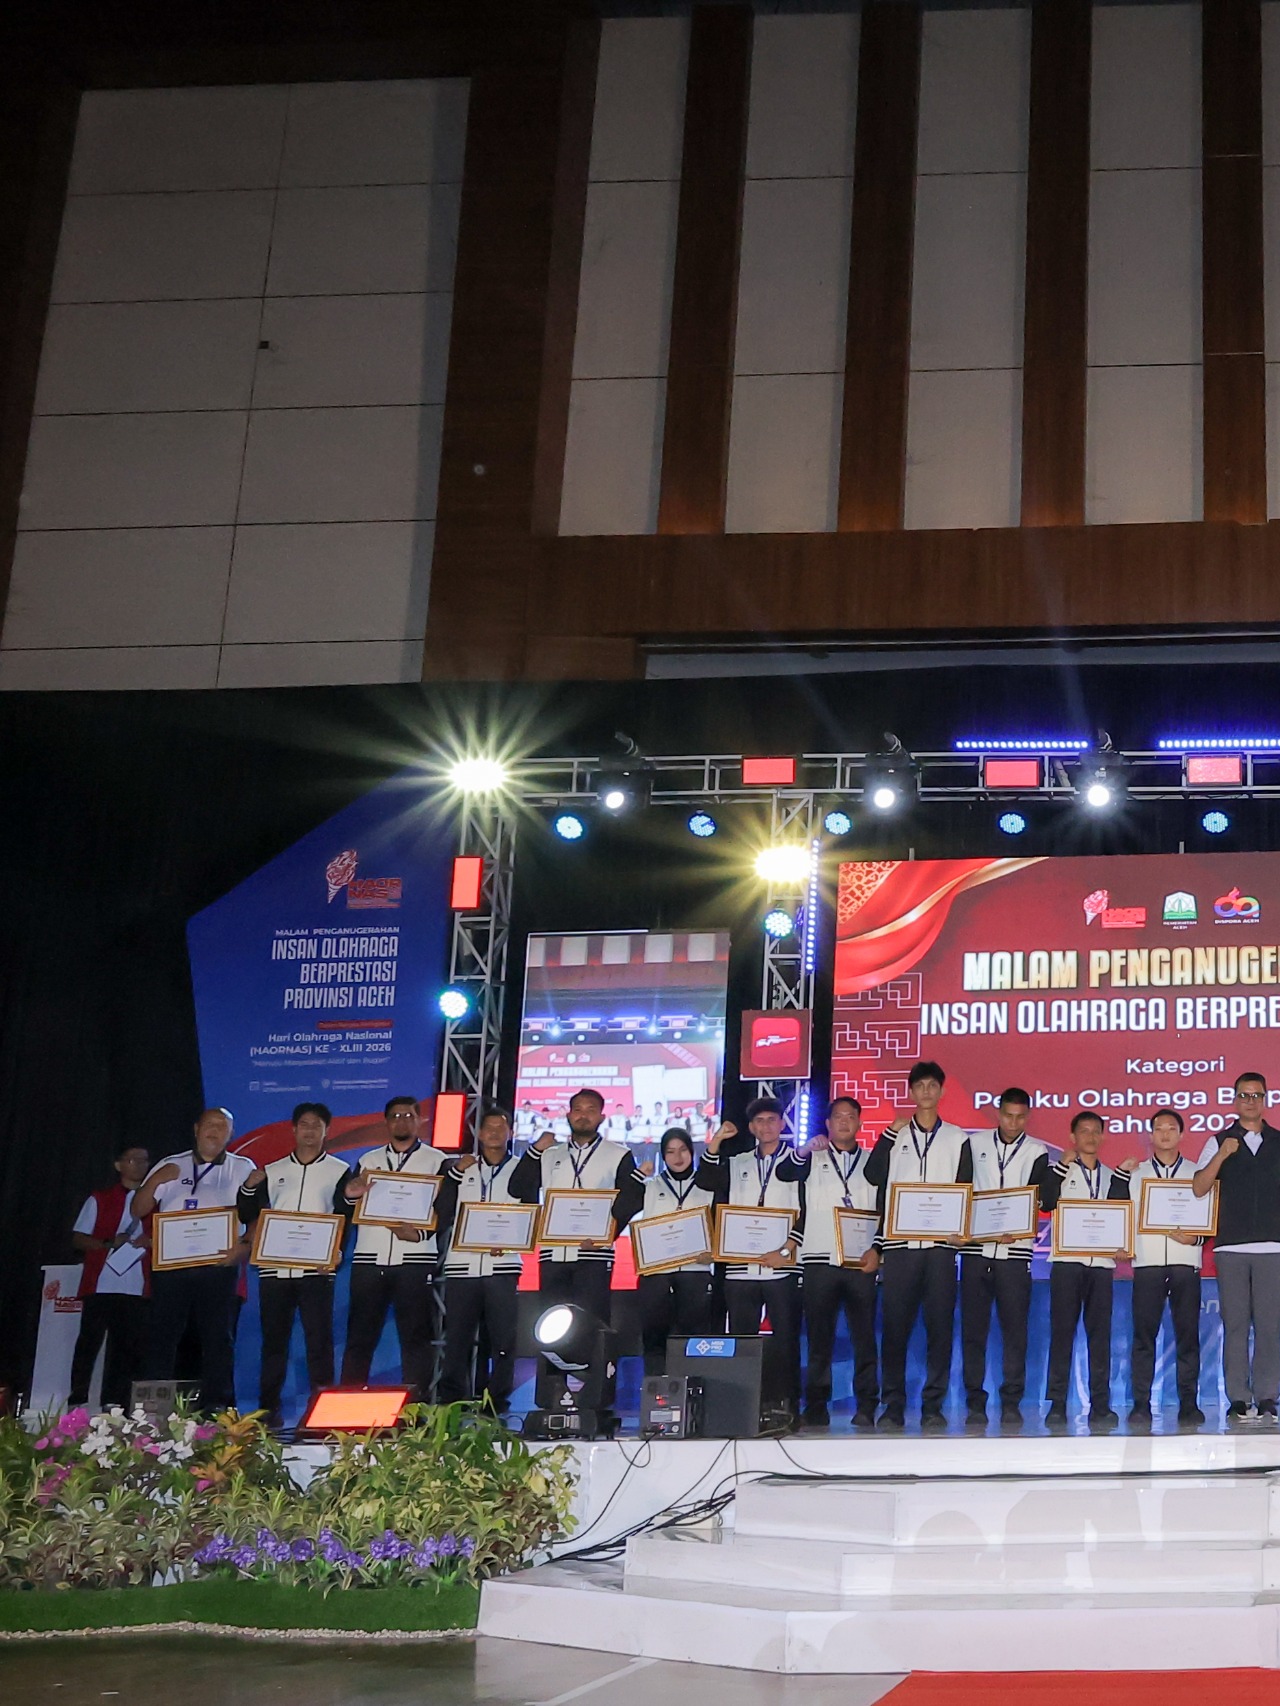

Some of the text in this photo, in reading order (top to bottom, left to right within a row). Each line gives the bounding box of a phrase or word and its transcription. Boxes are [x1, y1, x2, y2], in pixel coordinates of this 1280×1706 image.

[275, 926, 400, 936] MALAM PENGANUGERAHAN
[271, 936, 399, 960] INSAN OLAHRAGA
[300, 961, 397, 985] BERPRESTASI
[963, 950, 1078, 991] MALAM
[284, 985, 395, 1009] PROVINSI ACEH
[920, 1001, 1008, 1036] INSAN
[1017, 998, 1166, 1034] OLAHRAGA
[268, 1030, 392, 1043] Hari Olahraga Nasional
[315, 1045, 330, 1054] KE
[339, 1044, 363, 1053] XLIII
[365, 1043, 392, 1052] 2026
[1126, 1056, 1225, 1077] Kategori
[974, 1090, 1070, 1109] Pku
[1078, 1088, 1207, 1110] Olahraga
[1190, 1113, 1240, 1132] 202
